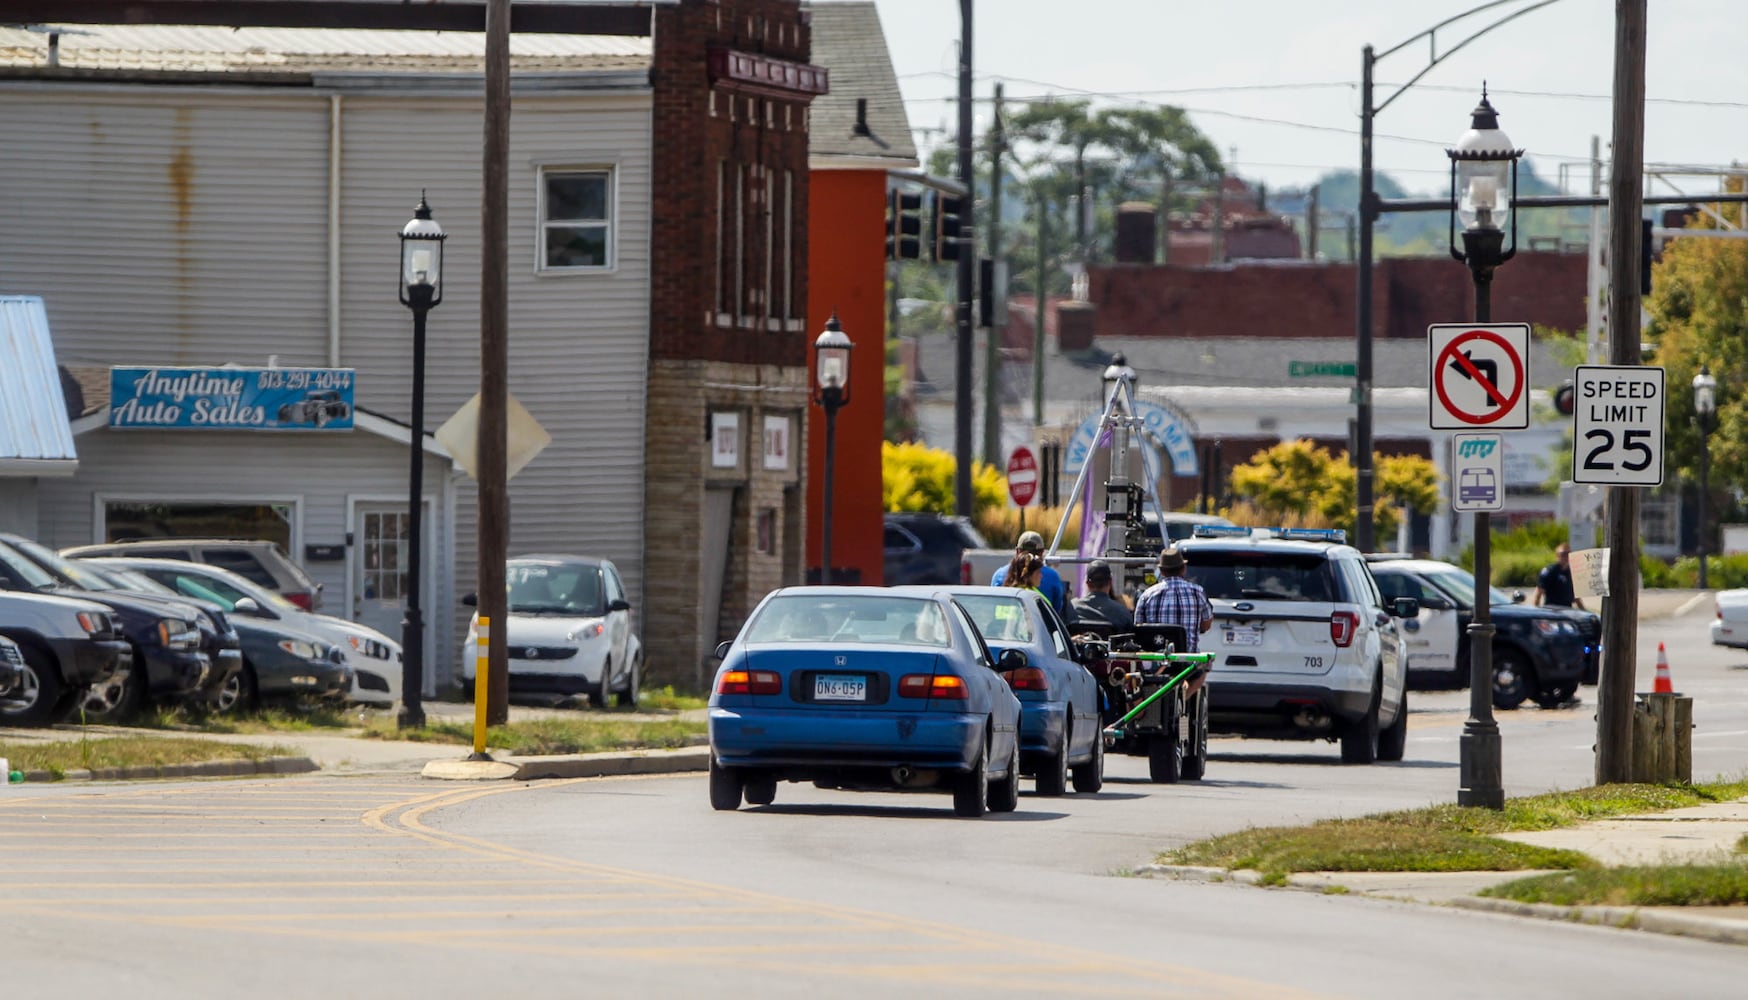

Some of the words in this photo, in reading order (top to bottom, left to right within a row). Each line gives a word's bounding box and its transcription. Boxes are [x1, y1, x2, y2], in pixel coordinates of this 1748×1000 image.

[134, 369, 243, 401] Anytime
[257, 371, 351, 389] 513-291-4044
[1583, 381, 1656, 399] SPEED
[112, 396, 183, 425] Auto
[190, 398, 265, 424] Sales
[1590, 405, 1648, 422] LIMIT
[1072, 408, 1190, 464] WEOME
[1583, 428, 1653, 471] 25
[1304, 656, 1323, 668] 703
